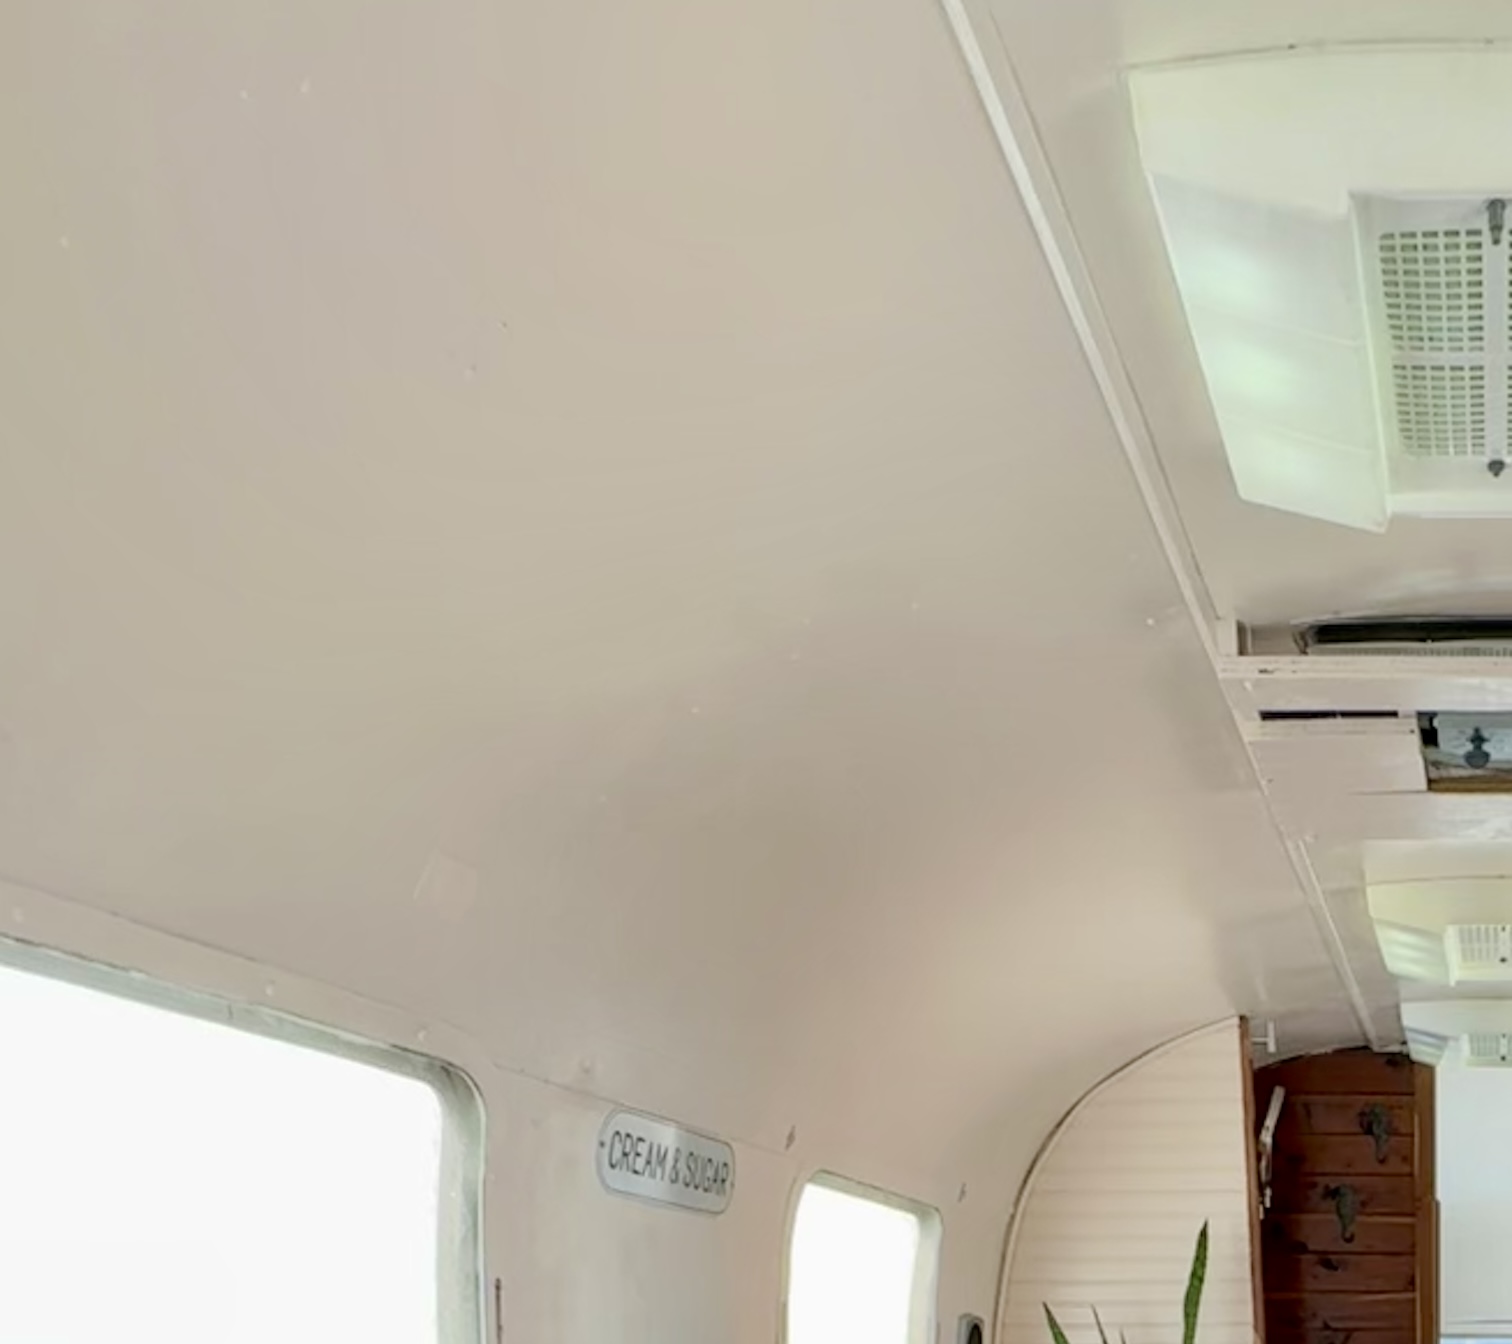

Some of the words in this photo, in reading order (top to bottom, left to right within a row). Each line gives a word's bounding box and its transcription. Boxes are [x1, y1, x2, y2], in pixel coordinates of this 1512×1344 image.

[608, 1130, 669, 1182] CREAM
[669, 1148, 682, 1185] &
[683, 1151, 729, 1196] SUGAR
